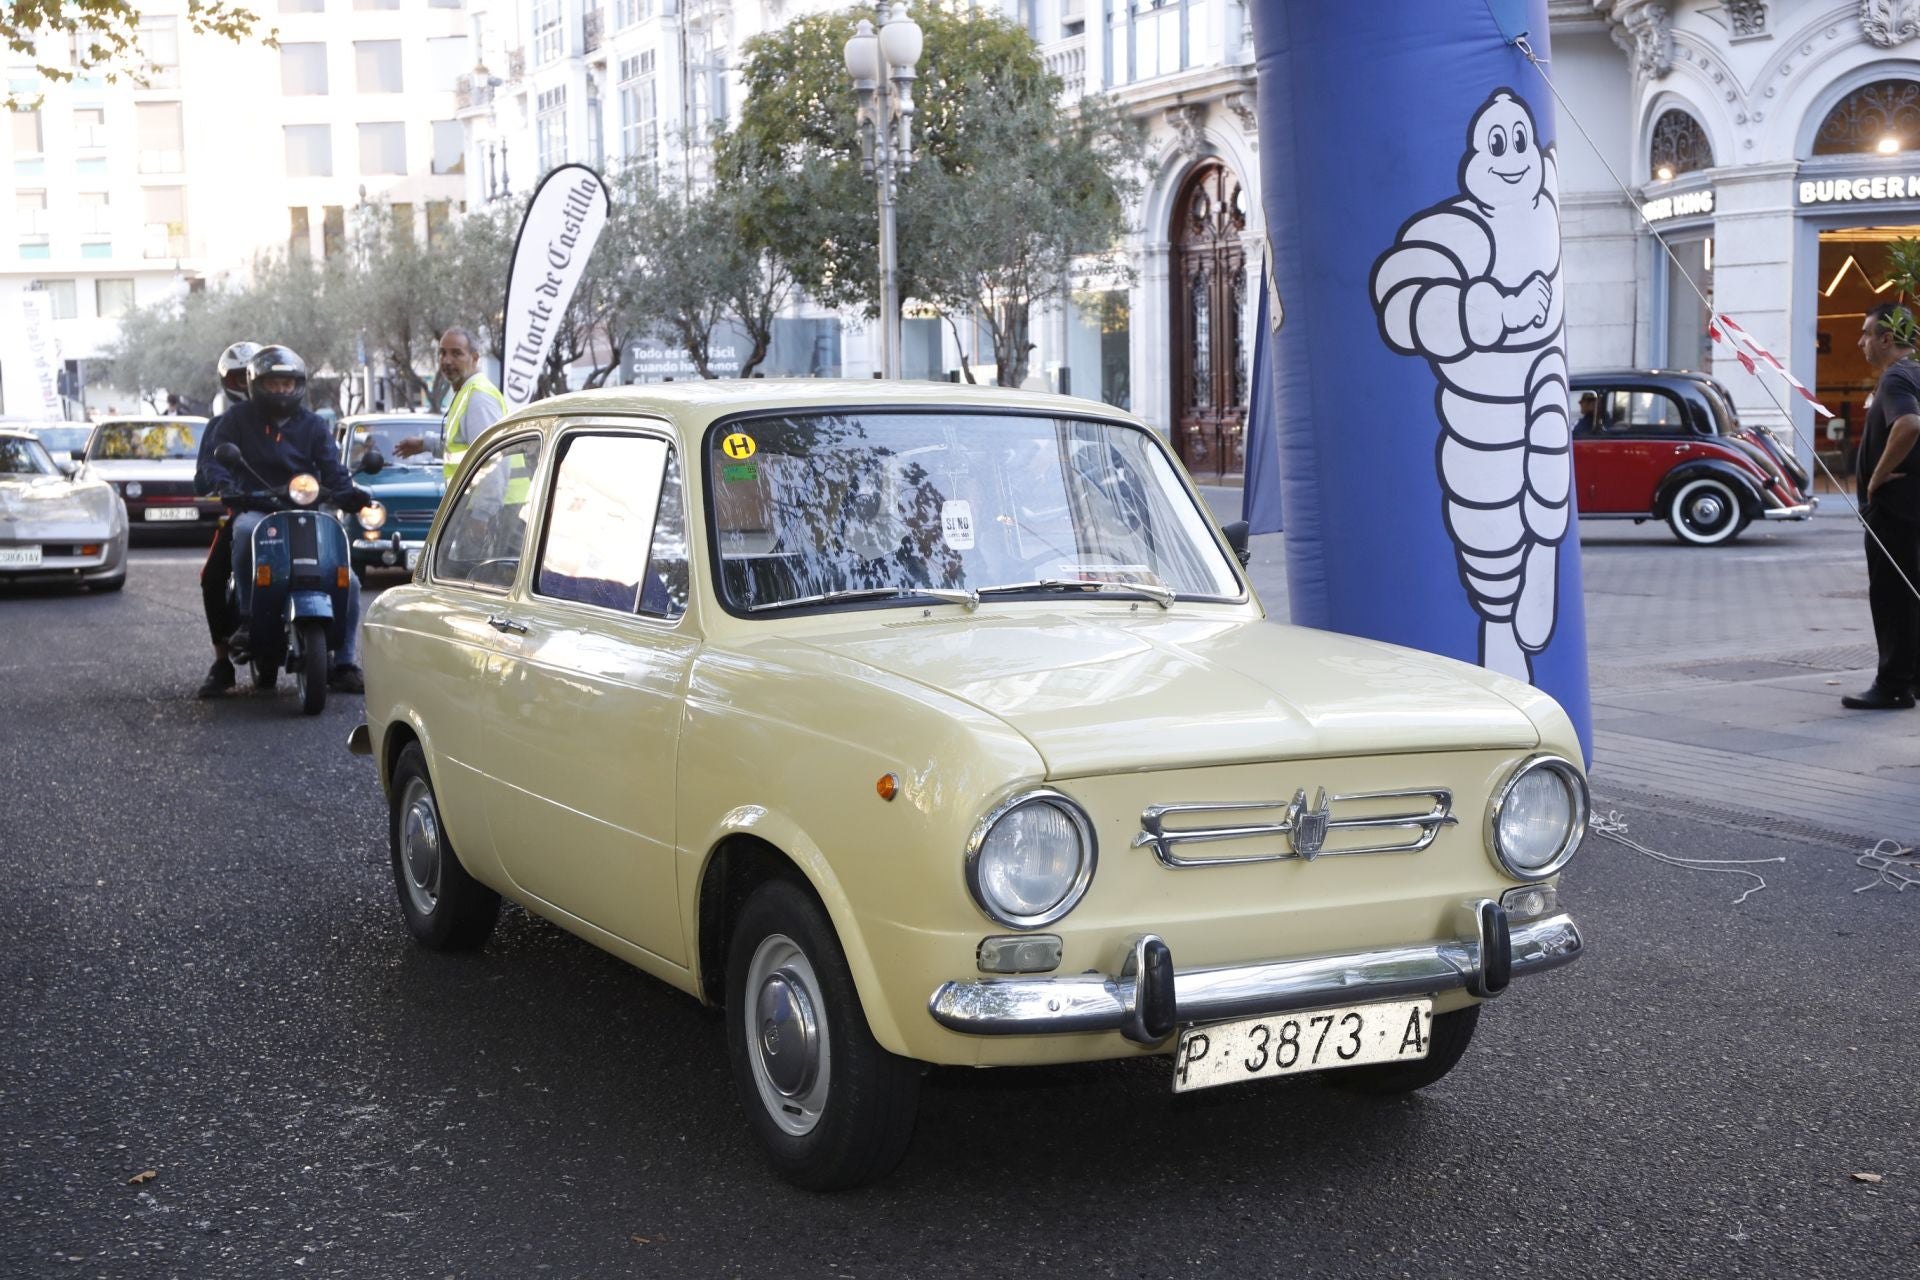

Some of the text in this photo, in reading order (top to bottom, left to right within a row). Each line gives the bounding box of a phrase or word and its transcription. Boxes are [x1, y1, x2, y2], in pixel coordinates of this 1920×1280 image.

[1800, 176, 1905, 204] BURGER
[506, 178, 599, 404] El Norte de Castilla
[632, 347, 662, 359] Todo
[664, 349, 679, 359] es
[632, 361, 677, 373] cuando
[729, 437, 751, 456] H
[1182, 1005, 1423, 1086] P 3873 A
